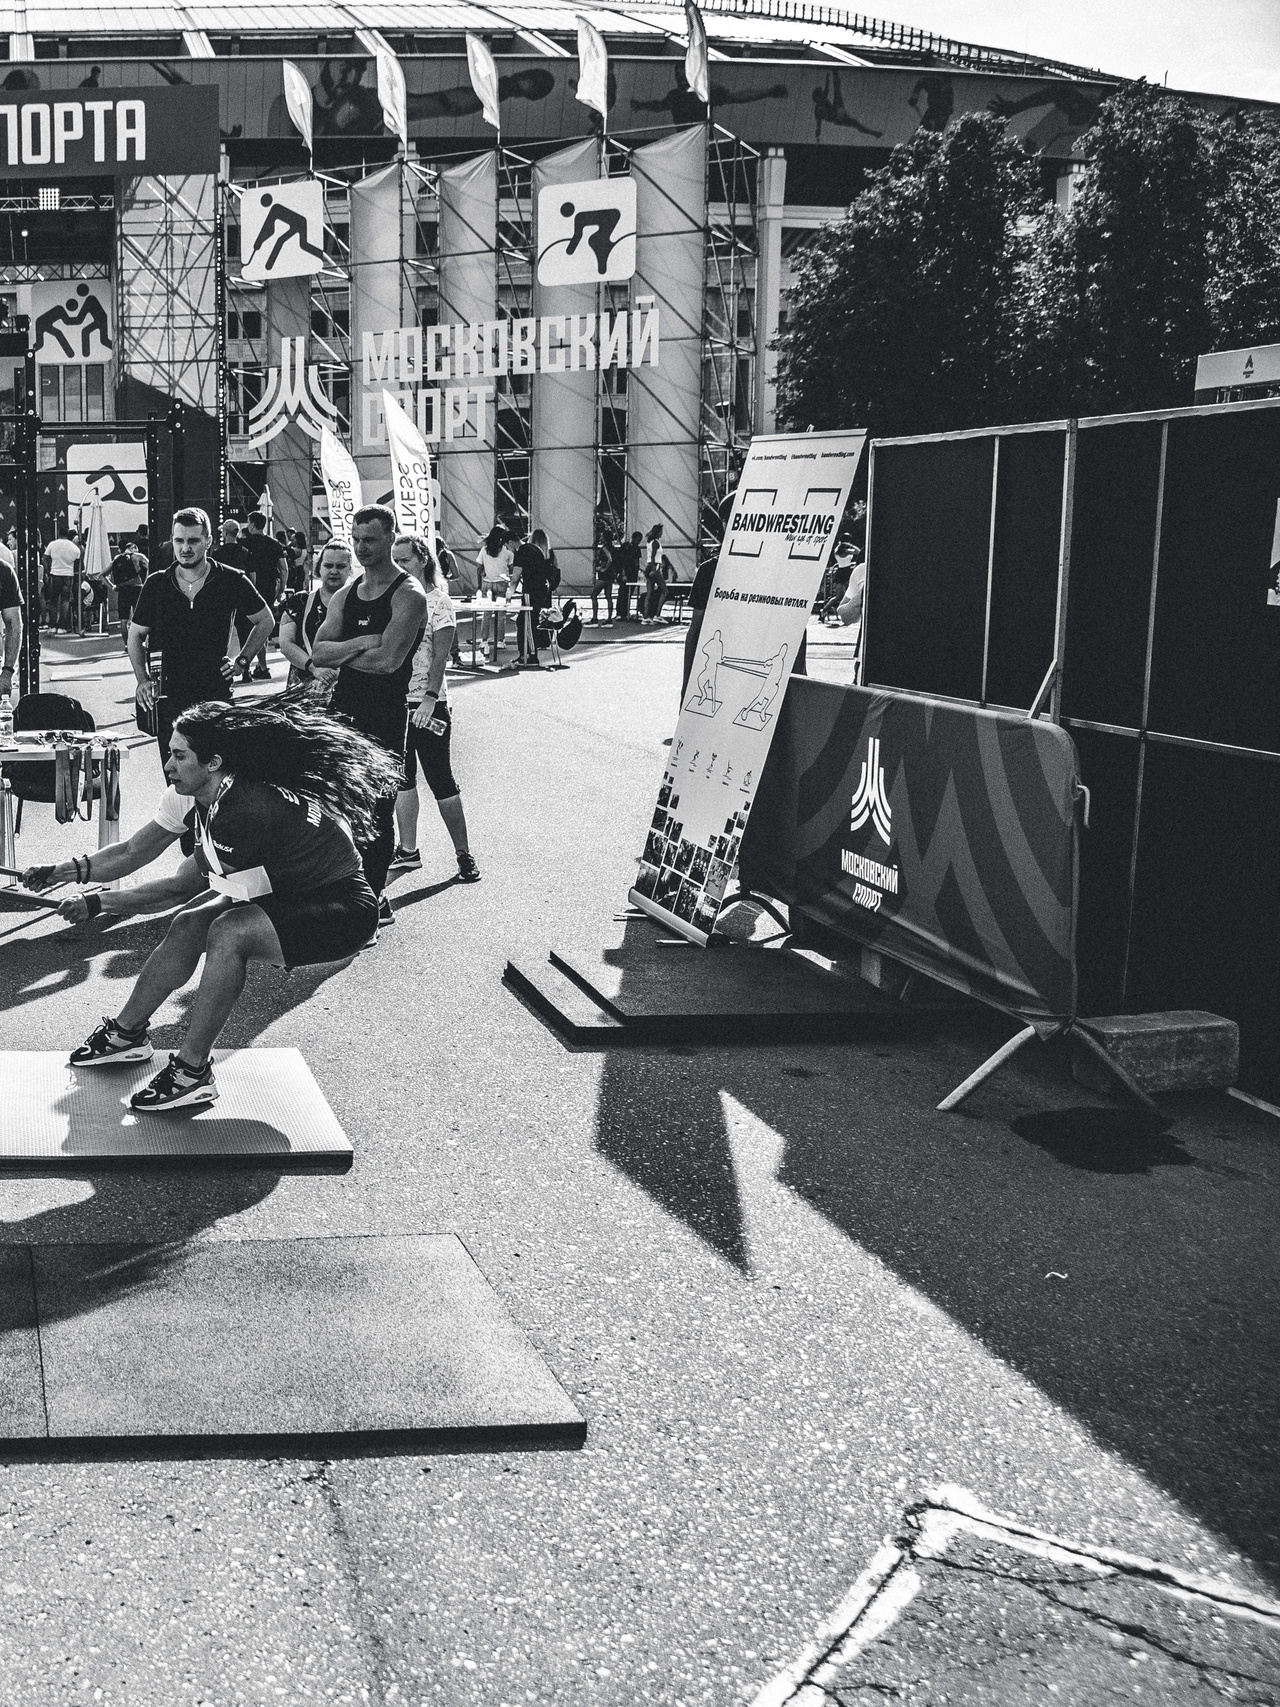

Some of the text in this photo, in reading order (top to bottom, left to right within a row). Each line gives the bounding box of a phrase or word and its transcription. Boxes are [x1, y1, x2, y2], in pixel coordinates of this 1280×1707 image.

[362, 296, 660, 385] МОСКОВСКИЙ
[731, 513, 835, 535] BANDWRESTLING
[714, 587, 808, 609] Борьба на резиновых петлях
[841, 848, 898, 895] МОСКОВСКИЙ
[852, 882, 883, 913] СПОРТ
